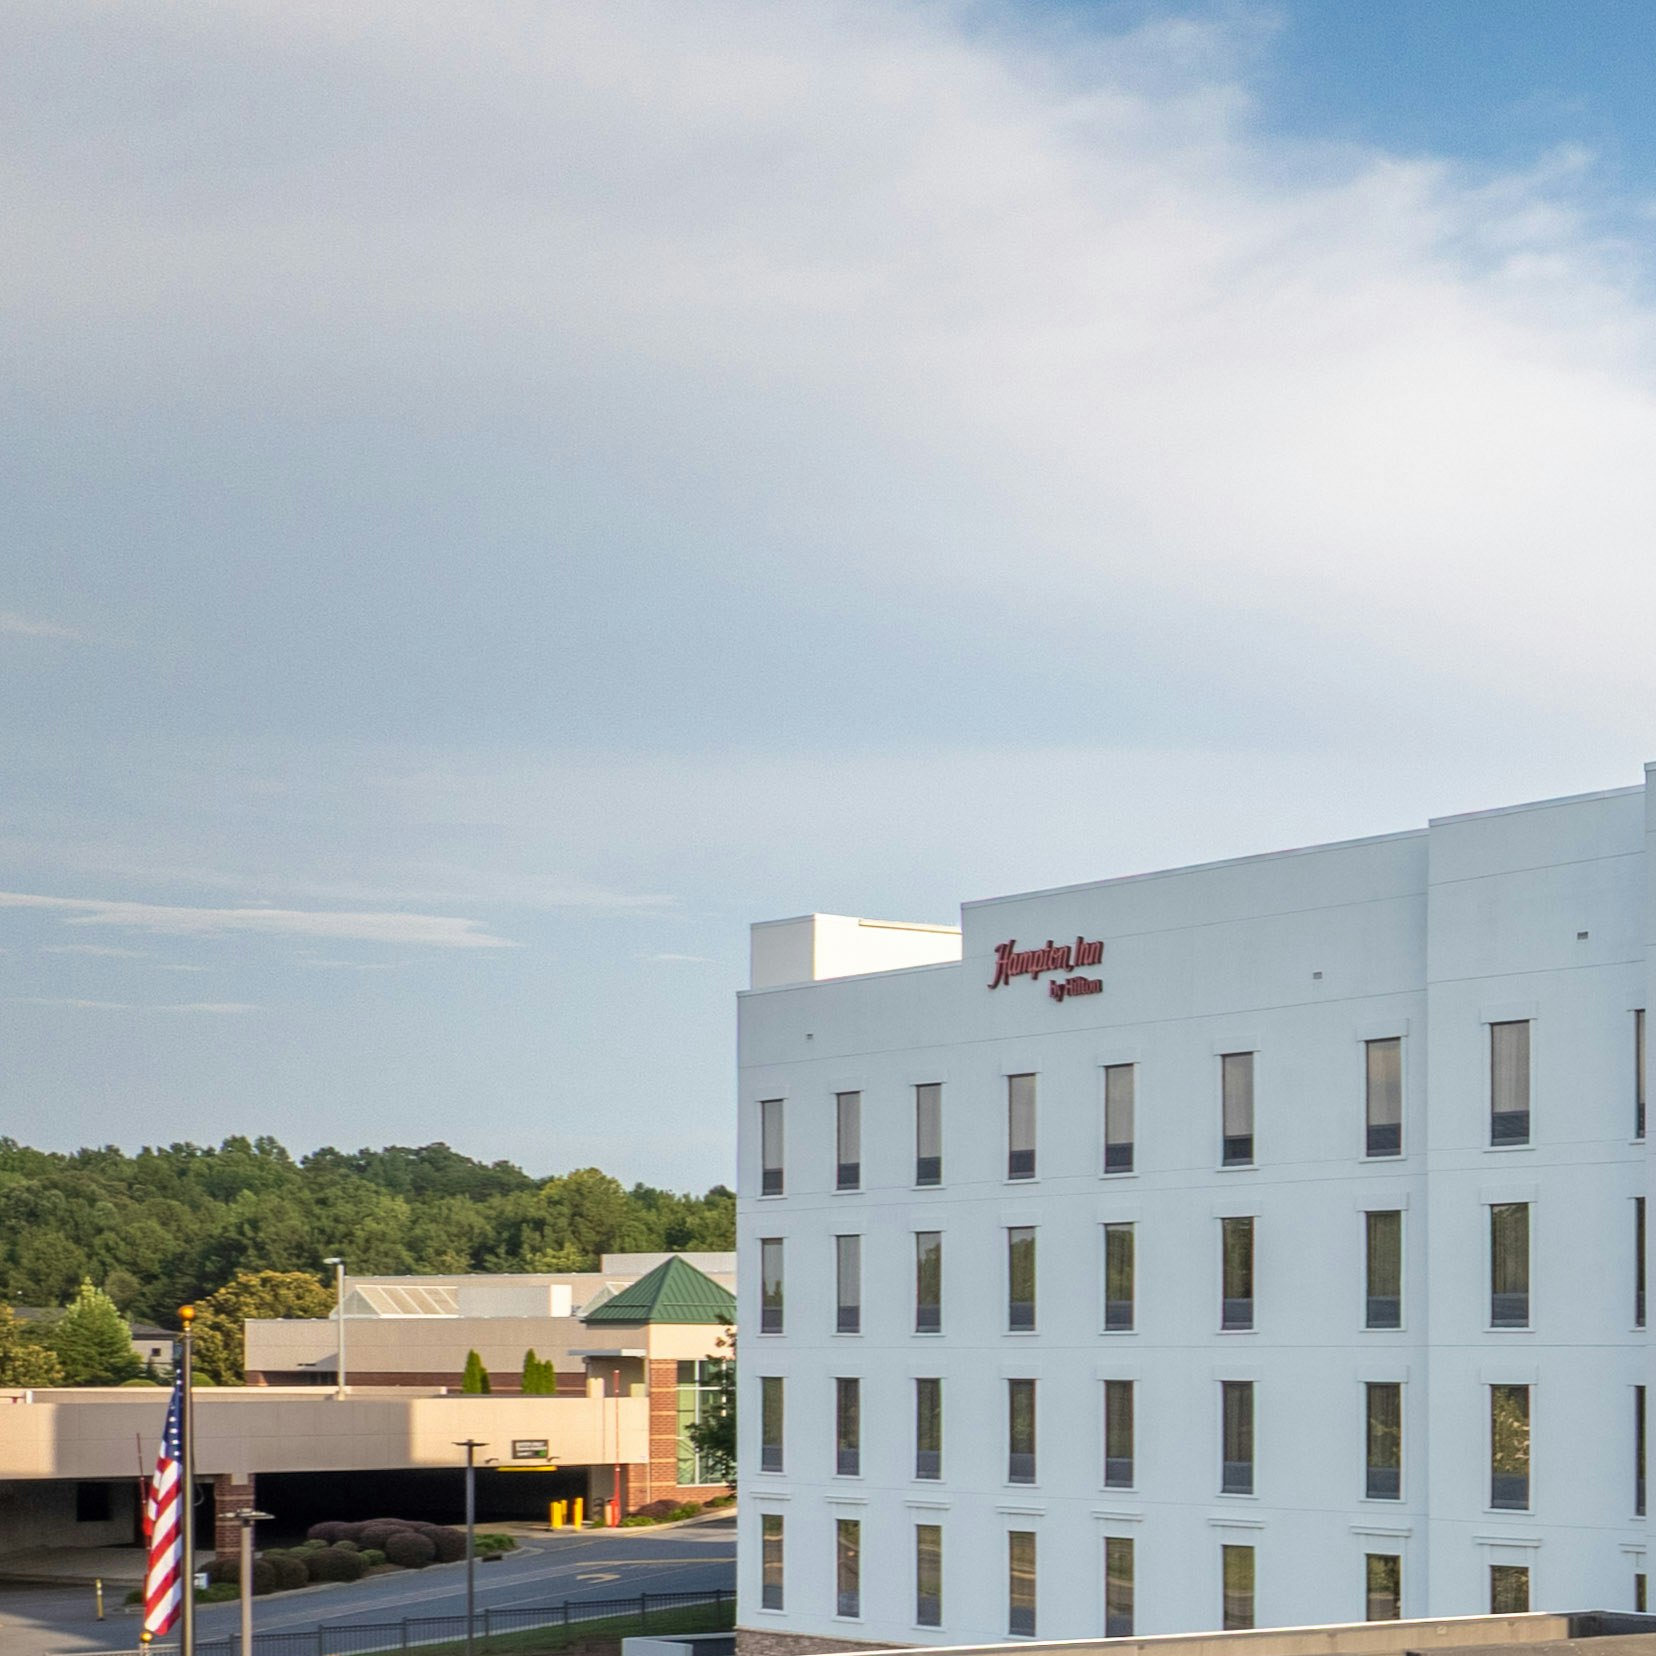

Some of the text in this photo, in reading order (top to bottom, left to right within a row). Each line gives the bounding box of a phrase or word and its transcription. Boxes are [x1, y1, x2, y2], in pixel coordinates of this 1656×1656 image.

[988, 936, 1104, 990] Hampton Inn
[1049, 976, 1103, 1002] by Hilton
